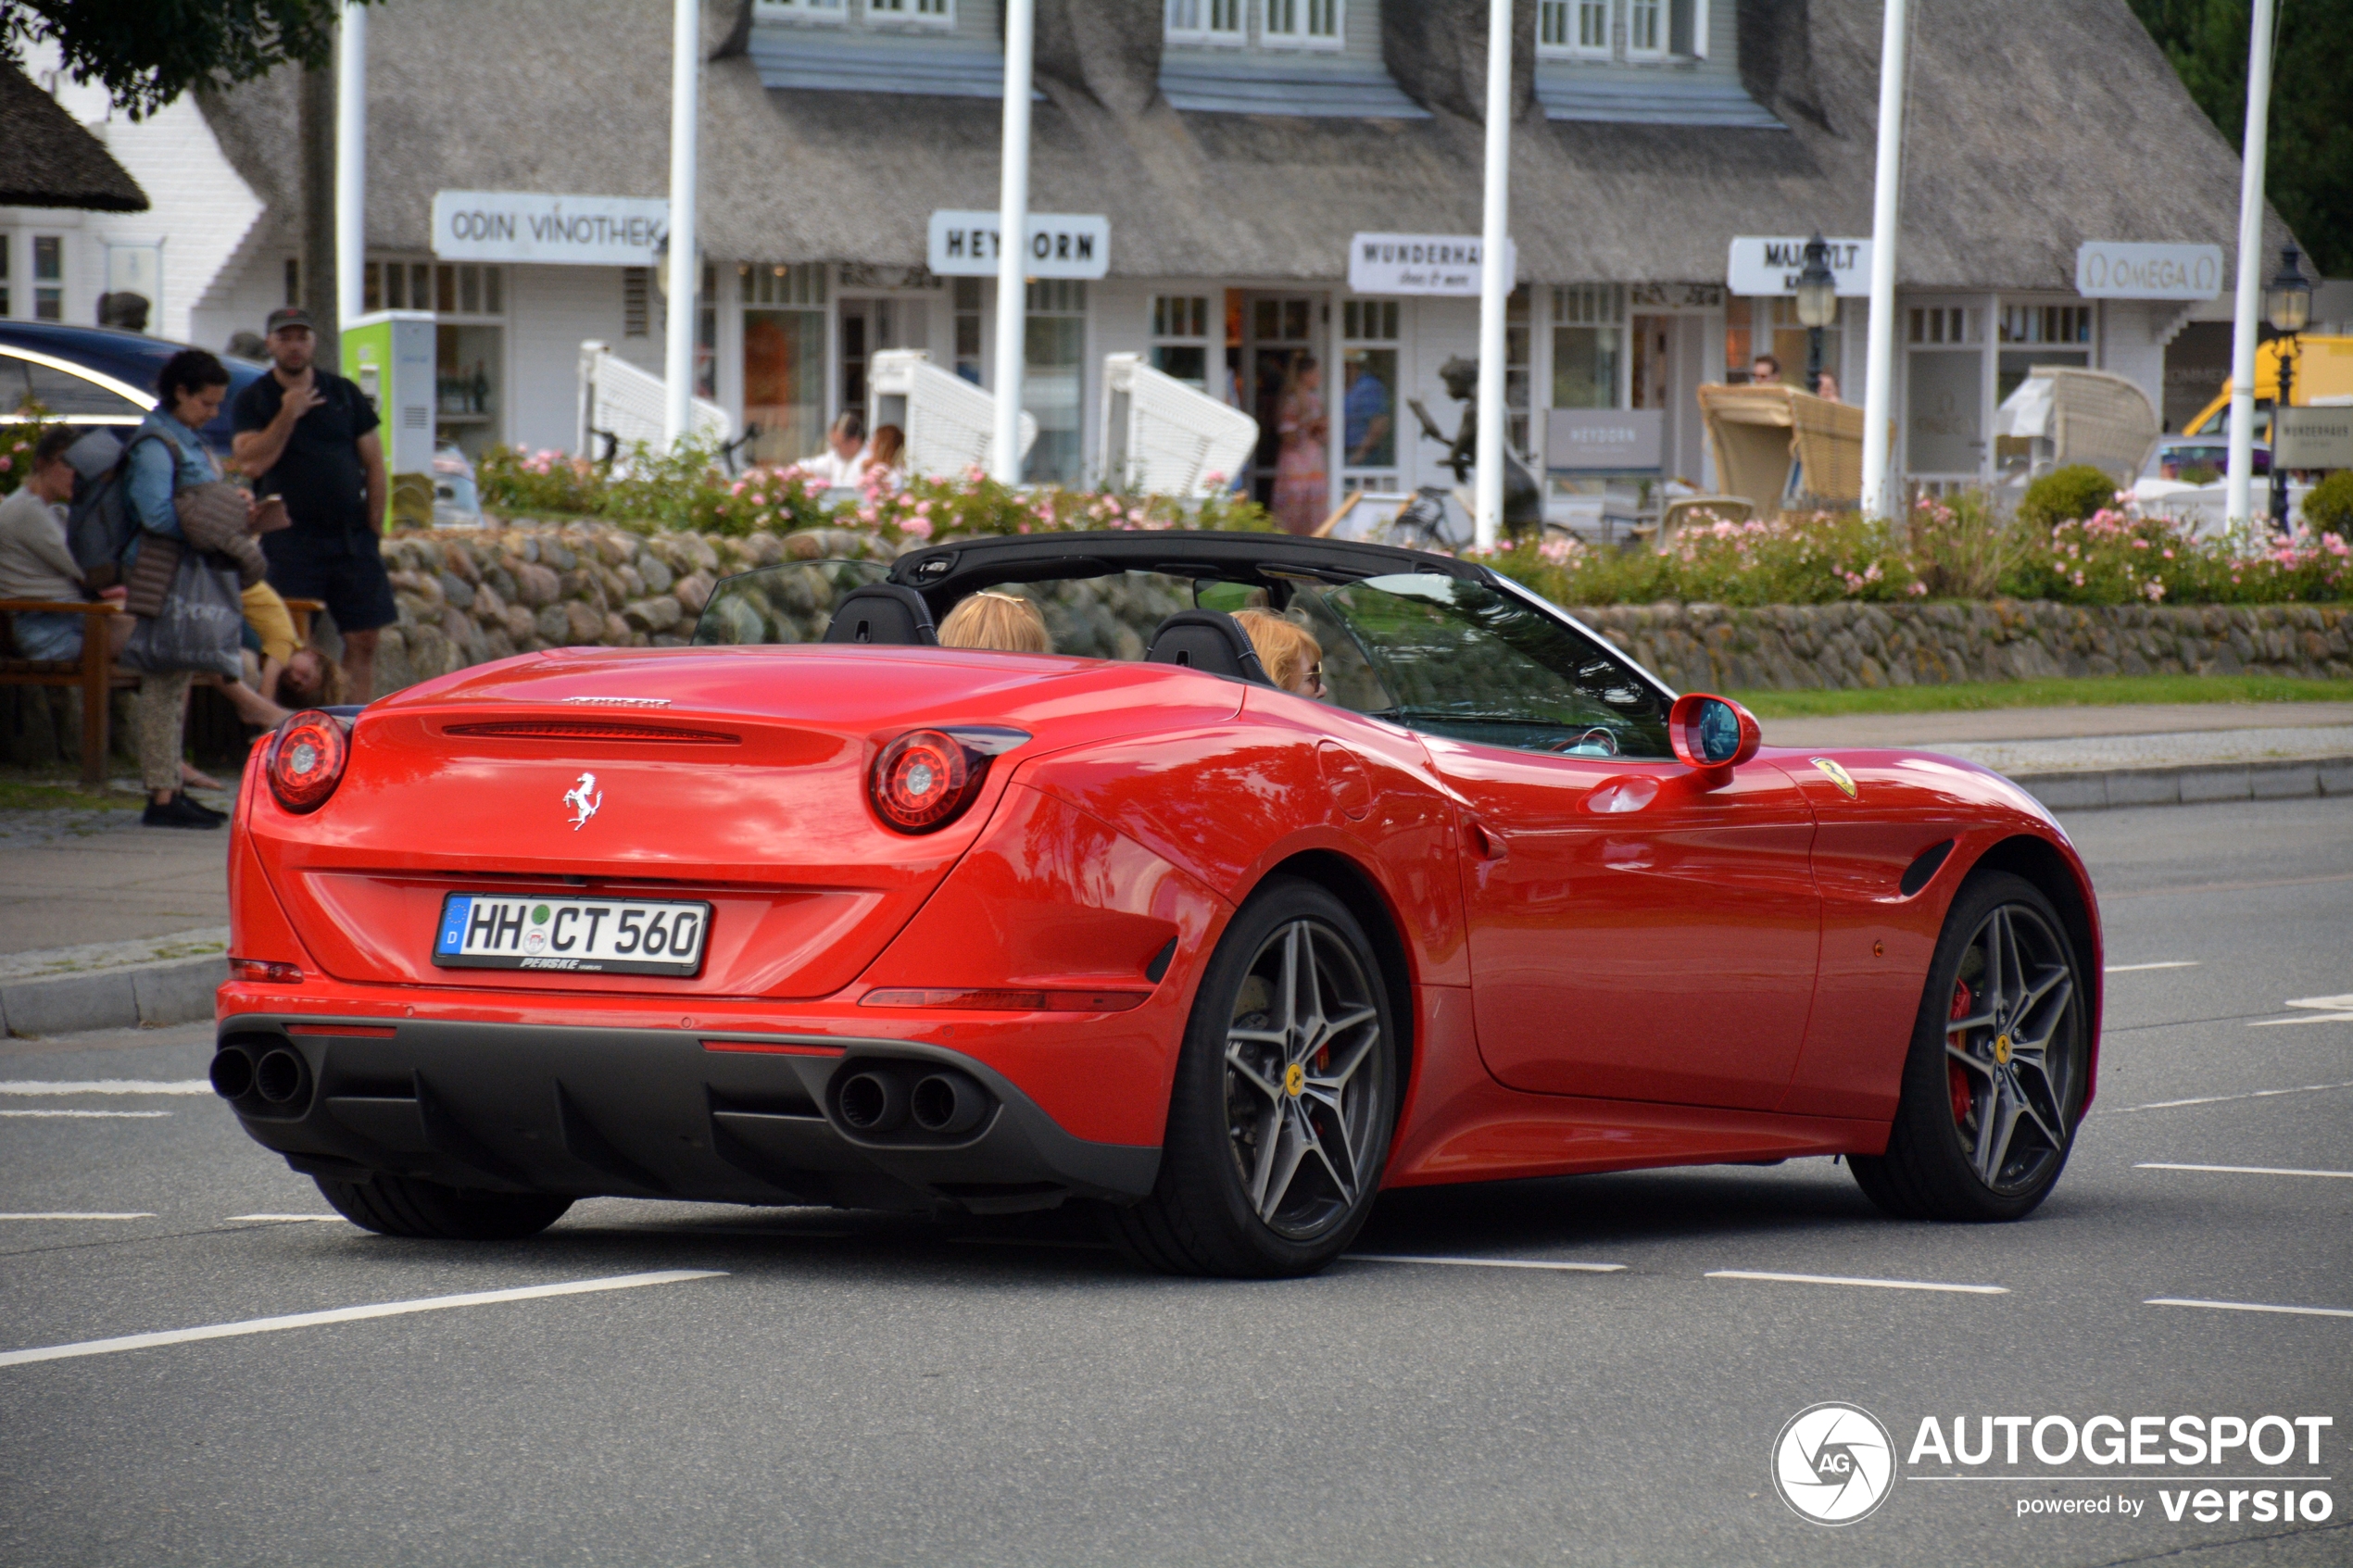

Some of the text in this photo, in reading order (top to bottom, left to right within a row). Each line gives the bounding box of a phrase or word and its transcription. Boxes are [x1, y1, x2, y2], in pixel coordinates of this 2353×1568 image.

[451, 211, 662, 246] ODIN VINOTHEK
[946, 229, 1095, 260] HEYORN
[2112, 258, 2189, 289] OMEGA
[447, 904, 699, 957] D HH CT 560
[519, 957, 581, 970] PENSKE
